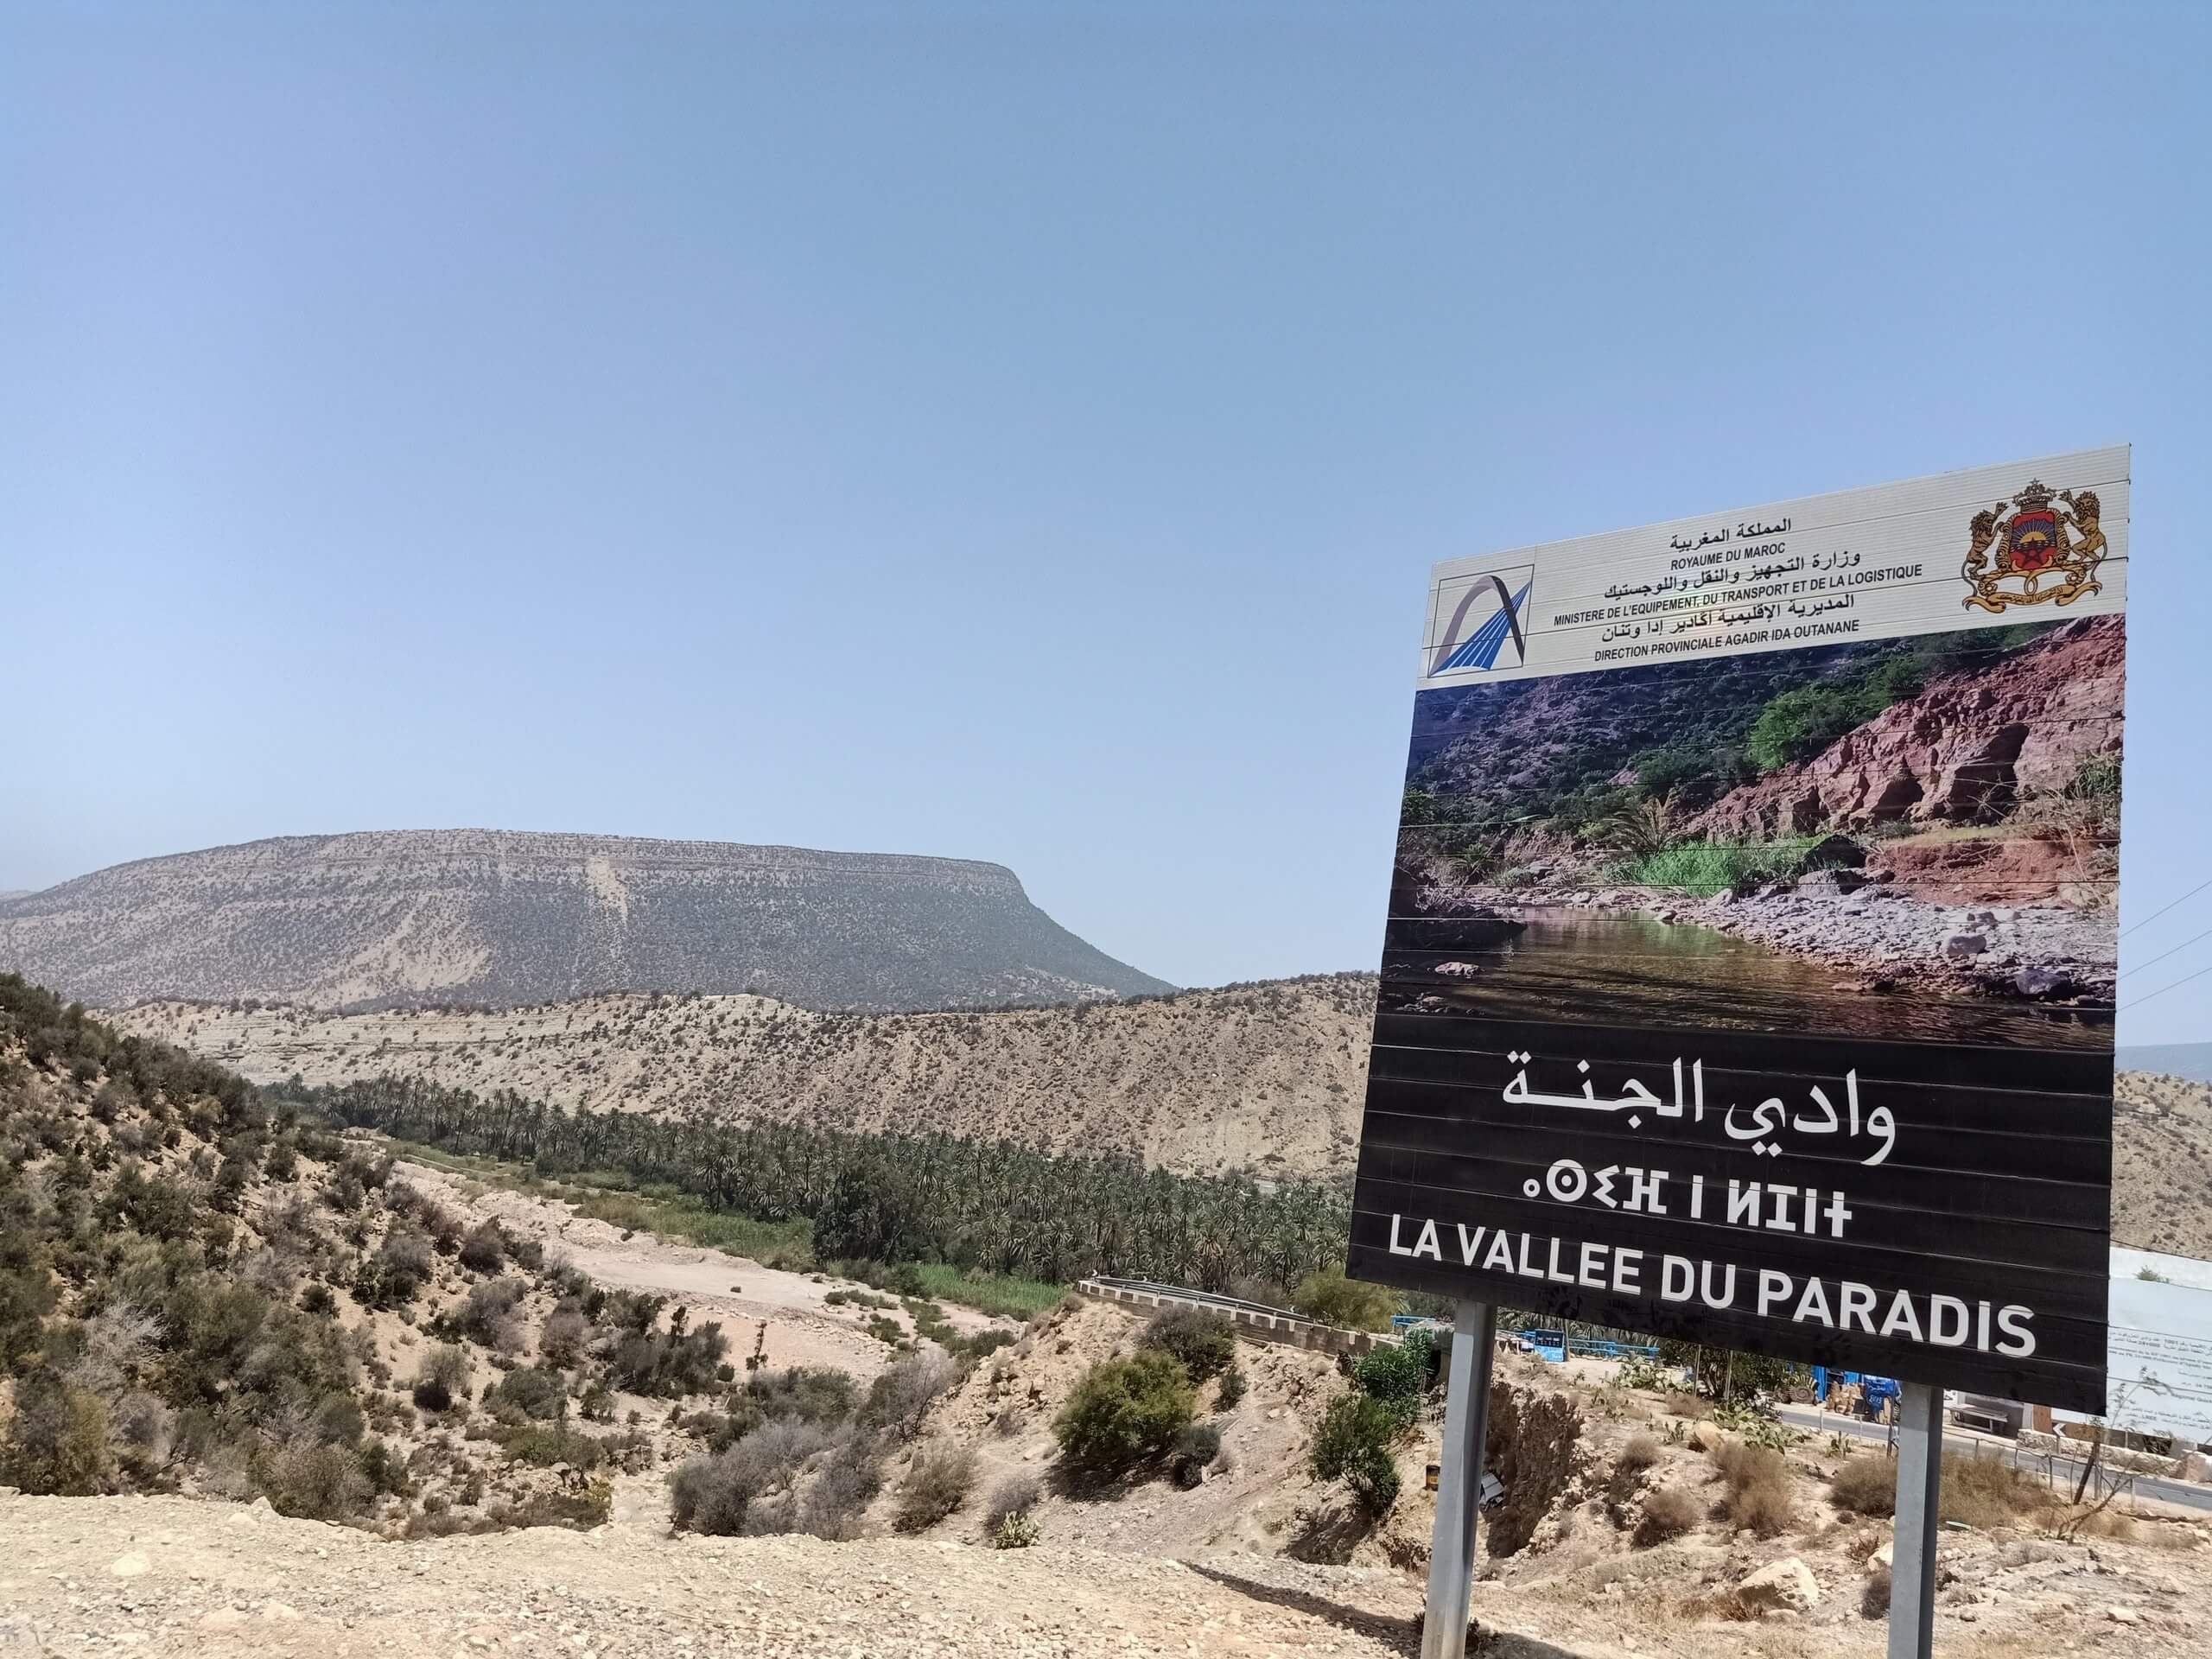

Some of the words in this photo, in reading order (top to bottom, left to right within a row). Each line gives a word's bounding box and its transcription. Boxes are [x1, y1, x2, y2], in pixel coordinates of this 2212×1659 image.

[1670, 529, 1729, 553] المغربية
[1736, 518, 1790, 538] المملكة
[1671, 551, 1722, 570] ROYAUME
[1726, 550, 1740, 562] DU
[1745, 543, 1785, 559] MAROC
[1745, 556, 1804, 582] التجهيز
[1812, 550, 1860, 570] وزارة
[1554, 608, 1605, 626] MINISTERE
[1607, 606, 1620, 619] DE
[1703, 592, 1718, 605] DU
[1722, 582, 1789, 602] TRANSPORT
[1792, 580, 1807, 594] ET
[1810, 577, 1826, 591] DE
[1829, 575, 1845, 588] LA
[1848, 564, 1923, 585] LOGISTIQUE
[1788, 594, 1854, 618] المديرية
[1594, 645, 1649, 662] DIRECTION
[1651, 636, 1722, 656] PROVINCIALE
[1725, 631, 1769, 646] AGADIR
[1771, 628, 1790, 641] IDA
[1795, 620, 1859, 638] OUTANANE
[1503, 1050, 1703, 1129] الجنة
[1725, 1069, 1896, 1166] وادي
[1389, 1214, 1441, 1261] LA
[1458, 1224, 1643, 1294] VALLEE
[1662, 1255, 1735, 1308] DU
[1758, 1269, 2035, 1358] PARADIS
